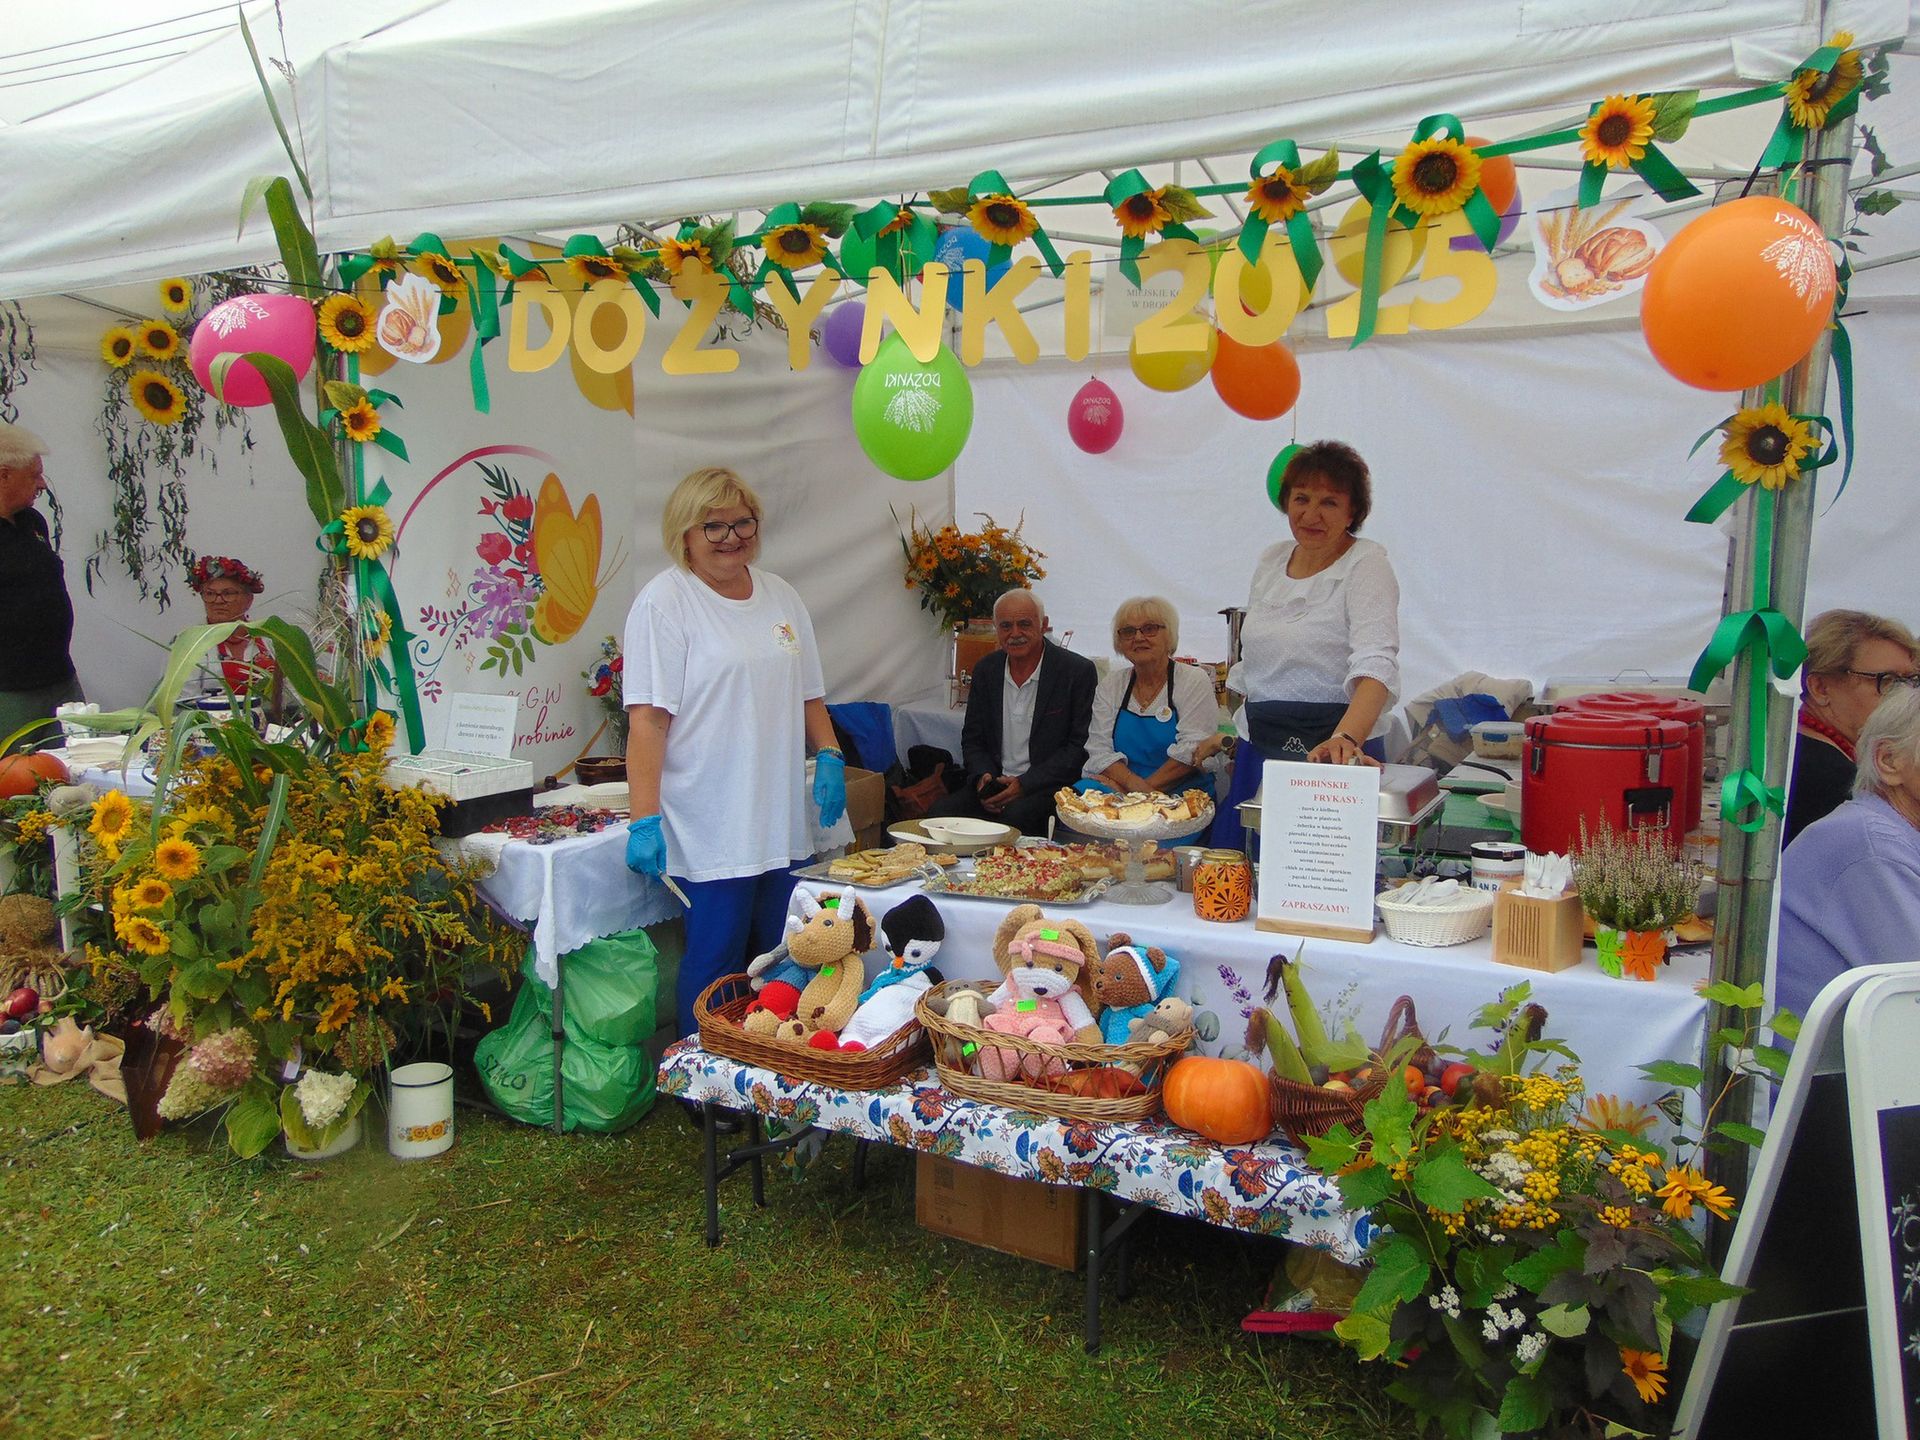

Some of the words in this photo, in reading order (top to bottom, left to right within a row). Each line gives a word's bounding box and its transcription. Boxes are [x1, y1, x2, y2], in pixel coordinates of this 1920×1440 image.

[1127, 289, 1168, 297] MIEJSKIE
[884, 372, 941, 390] DOŻYNKI
[1290, 778, 1350, 789] DROBIŃSKIE
[1314, 794, 1358, 804] FRYKASY
[1281, 899, 1350, 914] ZAPRASZAMY!
